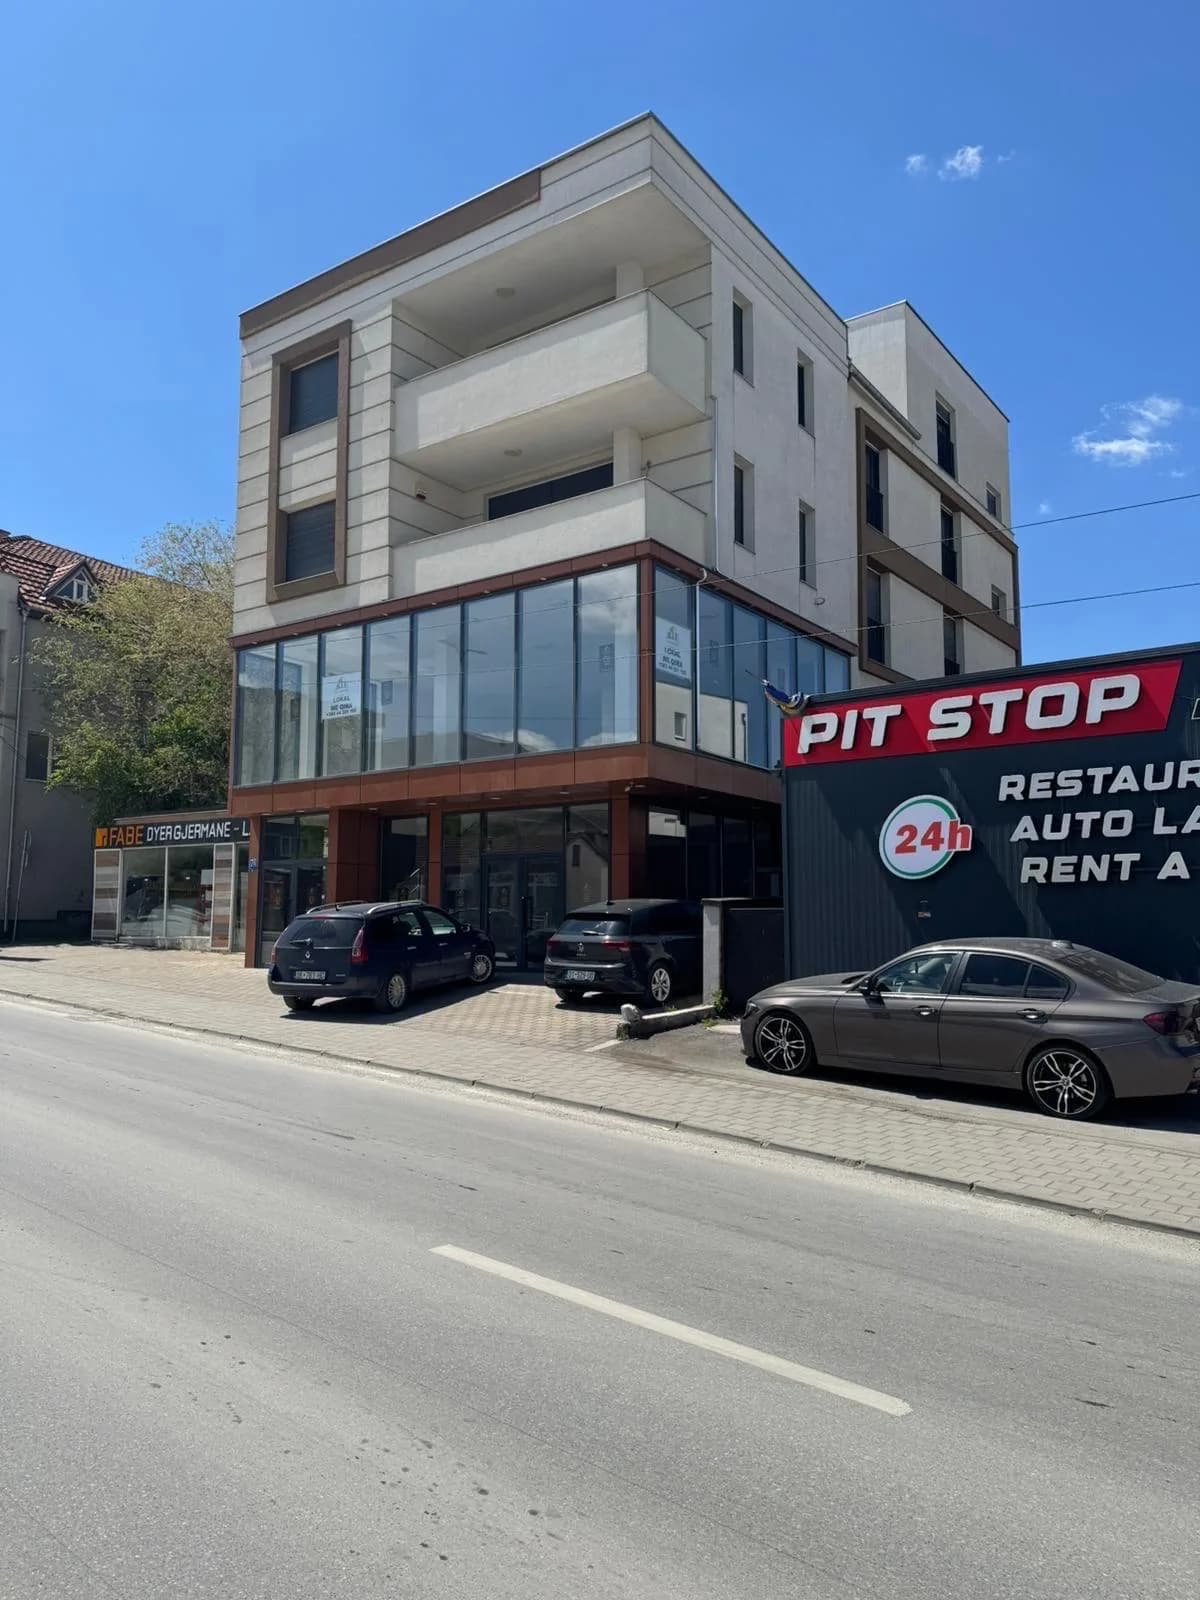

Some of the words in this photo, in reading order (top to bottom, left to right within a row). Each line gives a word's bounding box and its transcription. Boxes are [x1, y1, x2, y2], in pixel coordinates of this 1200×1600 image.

[797, 704, 902, 754] PIT
[927, 673, 1141, 741] STOP
[999, 760, 1200, 801] RESTAUR
[109, 825, 144, 846] FABE
[242, 820, 250, 837] L
[894, 820, 972, 855] 24h
[1009, 809, 1134, 842] AUTO
[1153, 805, 1200, 835] LA
[1020, 852, 1141, 884] RENT
[1157, 851, 1191, 880] A
